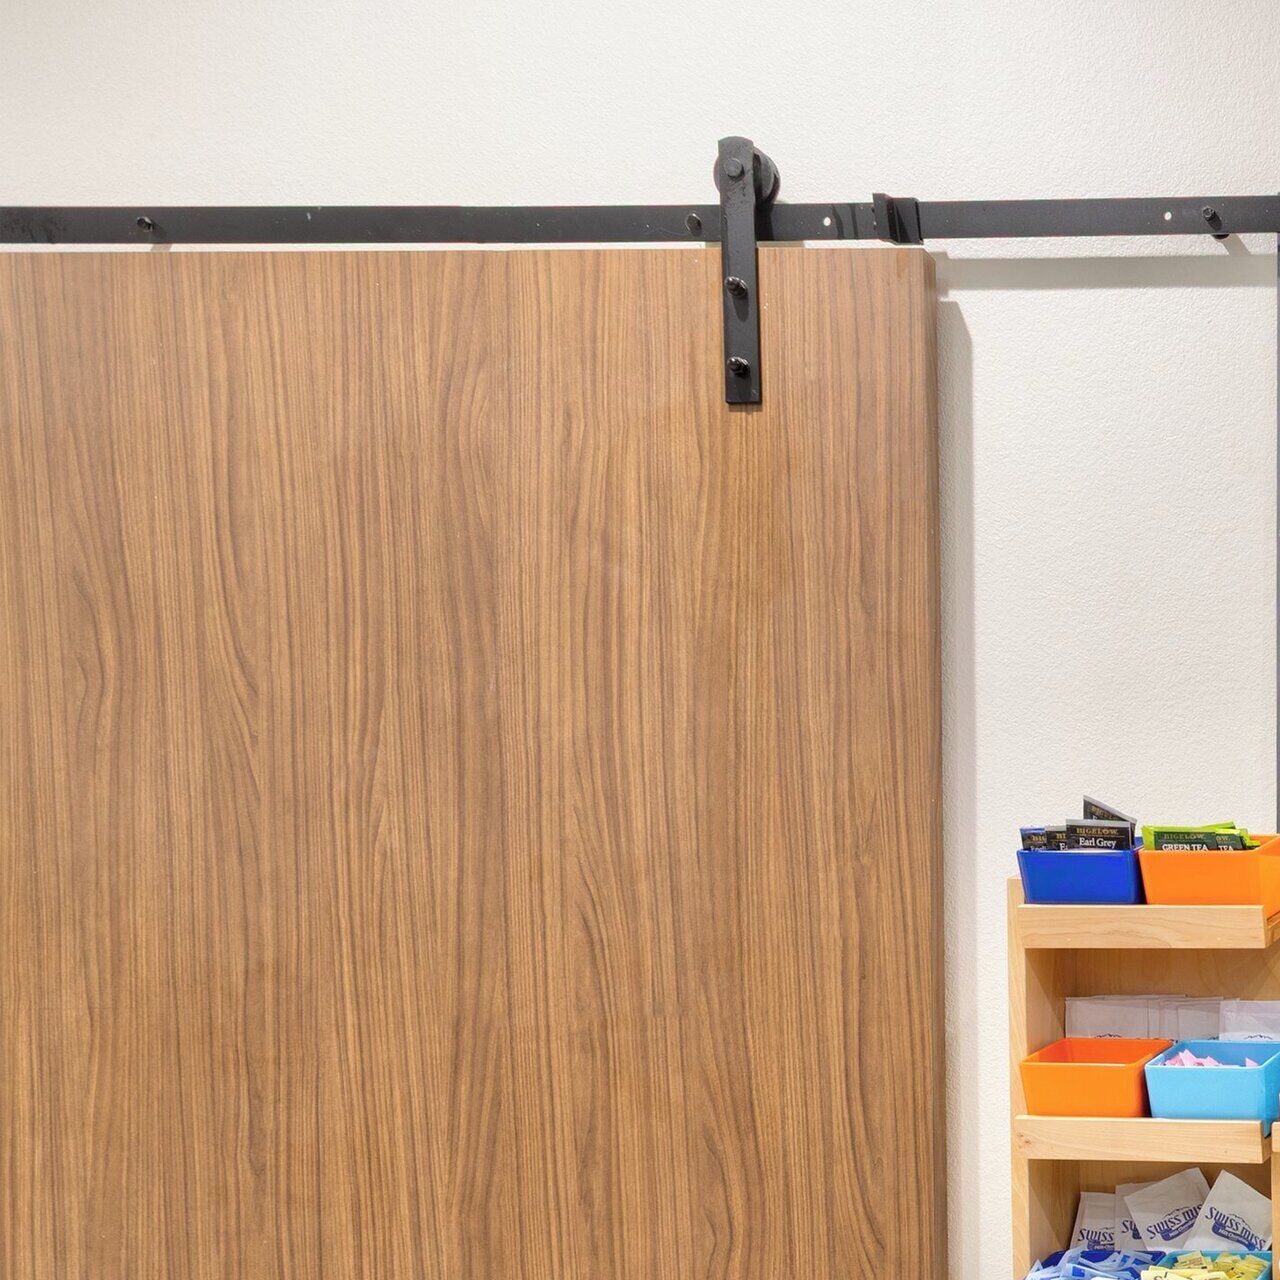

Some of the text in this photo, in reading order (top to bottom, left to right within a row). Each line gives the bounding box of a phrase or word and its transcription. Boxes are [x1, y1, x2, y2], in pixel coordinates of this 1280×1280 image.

[1076, 827, 1118, 835] BIGELOW
[1079, 837, 1117, 849] Earl Grey
[1205, 1206, 1241, 1231] Swiss
[1147, 1215, 1182, 1240] Swiss
[1078, 1228, 1114, 1242] Swiss
